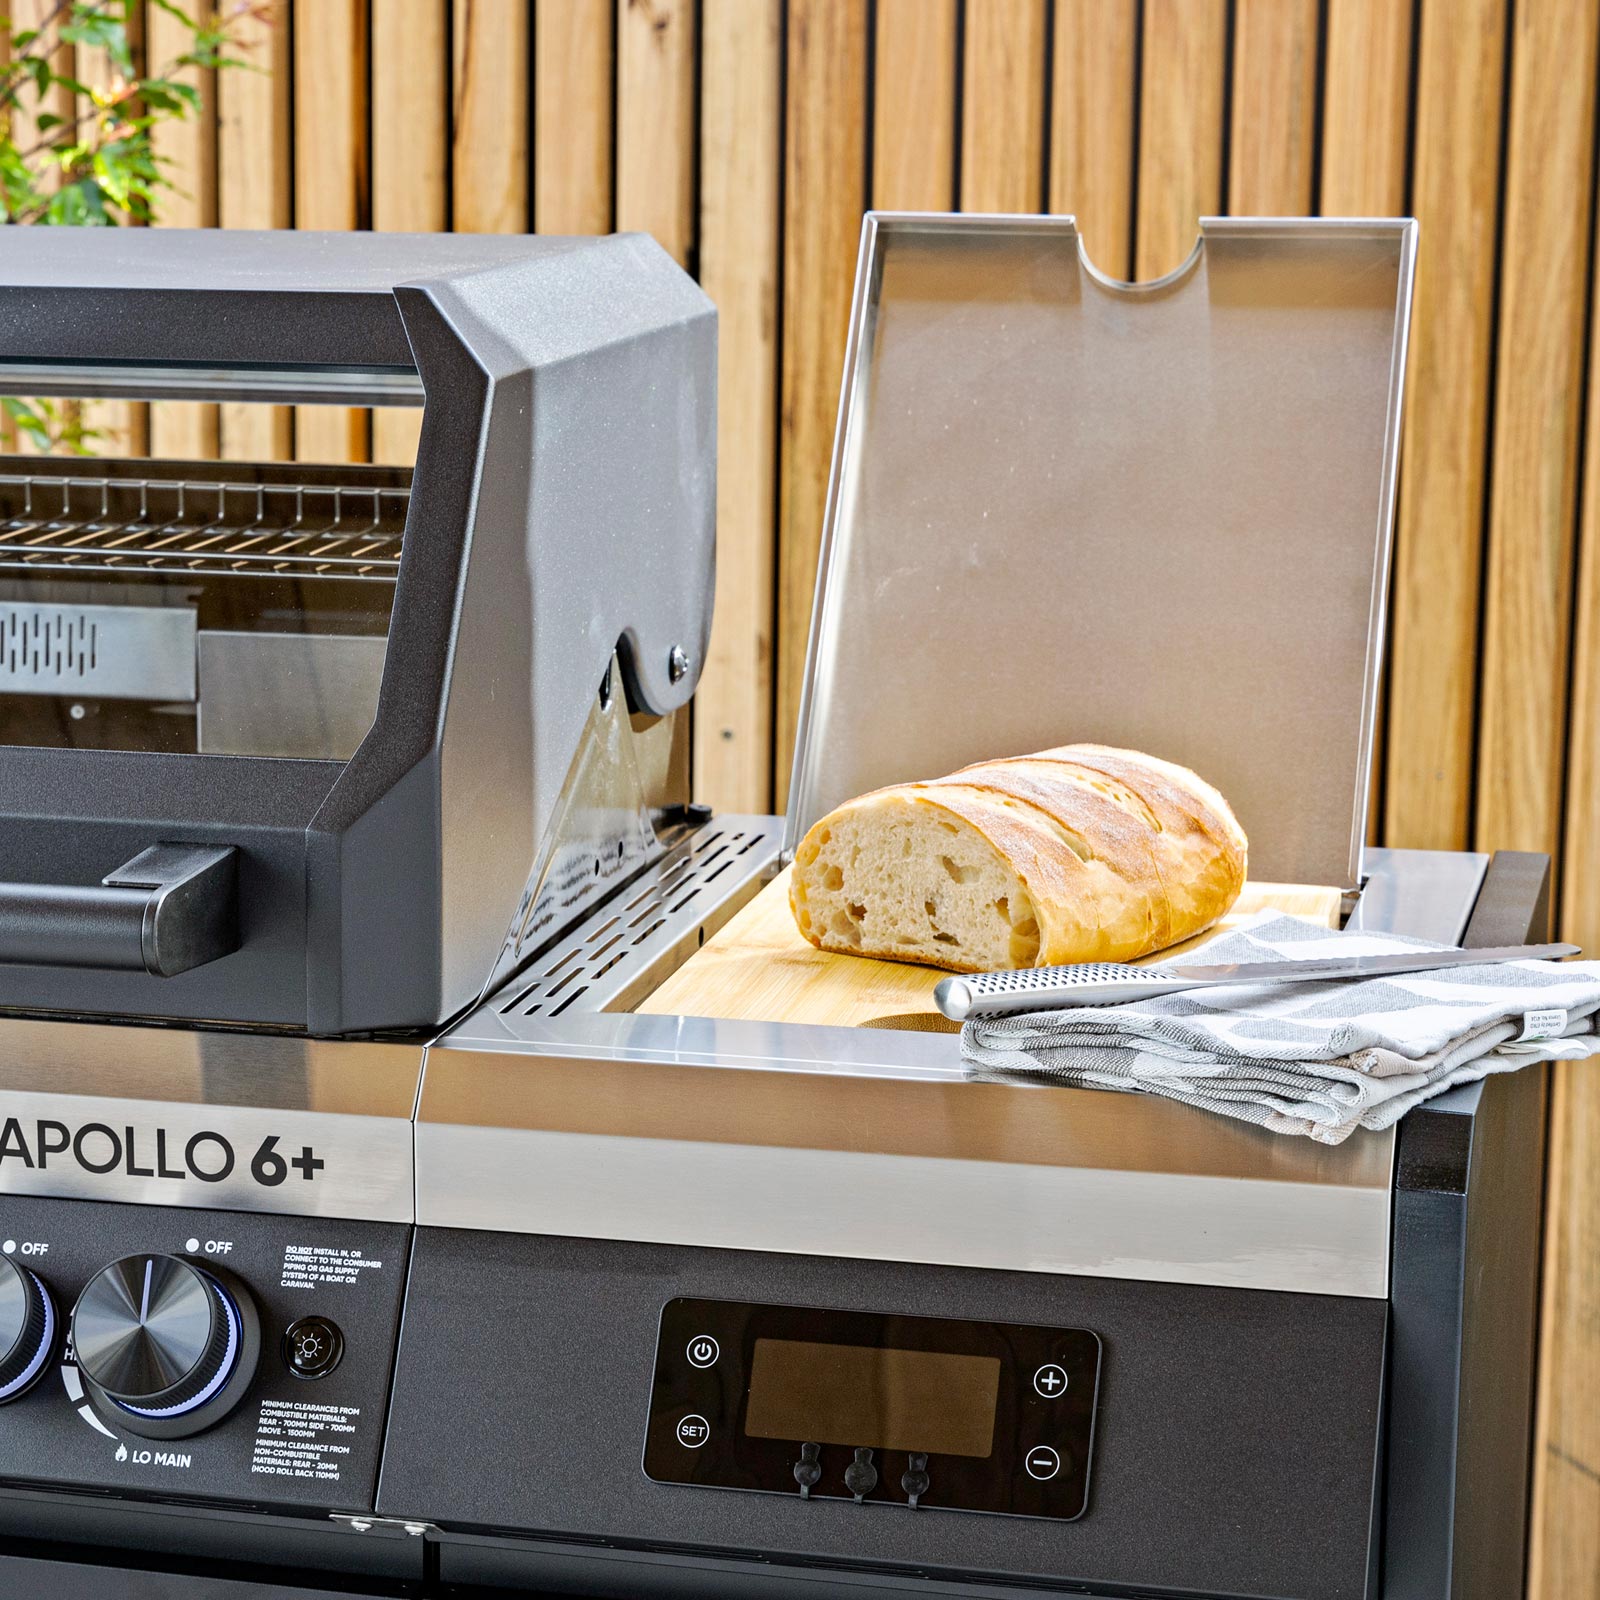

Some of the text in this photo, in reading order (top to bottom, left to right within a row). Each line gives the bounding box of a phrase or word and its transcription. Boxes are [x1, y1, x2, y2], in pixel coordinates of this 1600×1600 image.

[0, 1118, 324, 1187] APOLLO 6+
[21, 1242, 49, 1256] OFF
[204, 1240, 233, 1254] OFF
[314, 1248, 339, 1256] INSTALL
[285, 1255, 318, 1263] CONNECT
[343, 1259, 382, 1268] CONSUMER
[284, 1263, 306, 1271] PIPING
[335, 1267, 359, 1275] SUPPLY
[281, 1280, 315, 1288] CARAVAN.
[262, 1400, 360, 1415] MINIMUM CLEARANCES FROM
[260, 1409, 347, 1423] COMBUSTIBLE MATERIALS:
[284, 1420, 307, 1428] 700MM
[331, 1424, 355, 1432] 700MM
[681, 1425, 706, 1437] SET
[287, 1429, 315, 1438] 1500MM
[256, 1439, 350, 1454] MINIMUM CLEARANCE FROM
[132, 1450, 191, 1468] LO MAIN
[254, 1448, 320, 1460] NON-COMBUSTIBLE
[253, 1457, 291, 1466] MATERIALS:
[293, 1460, 310, 1468] REAR
[252, 1465, 275, 1473] (HOOD
[295, 1469, 313, 1477] BACK
[315, 1471, 339, 1480] 110MM)
